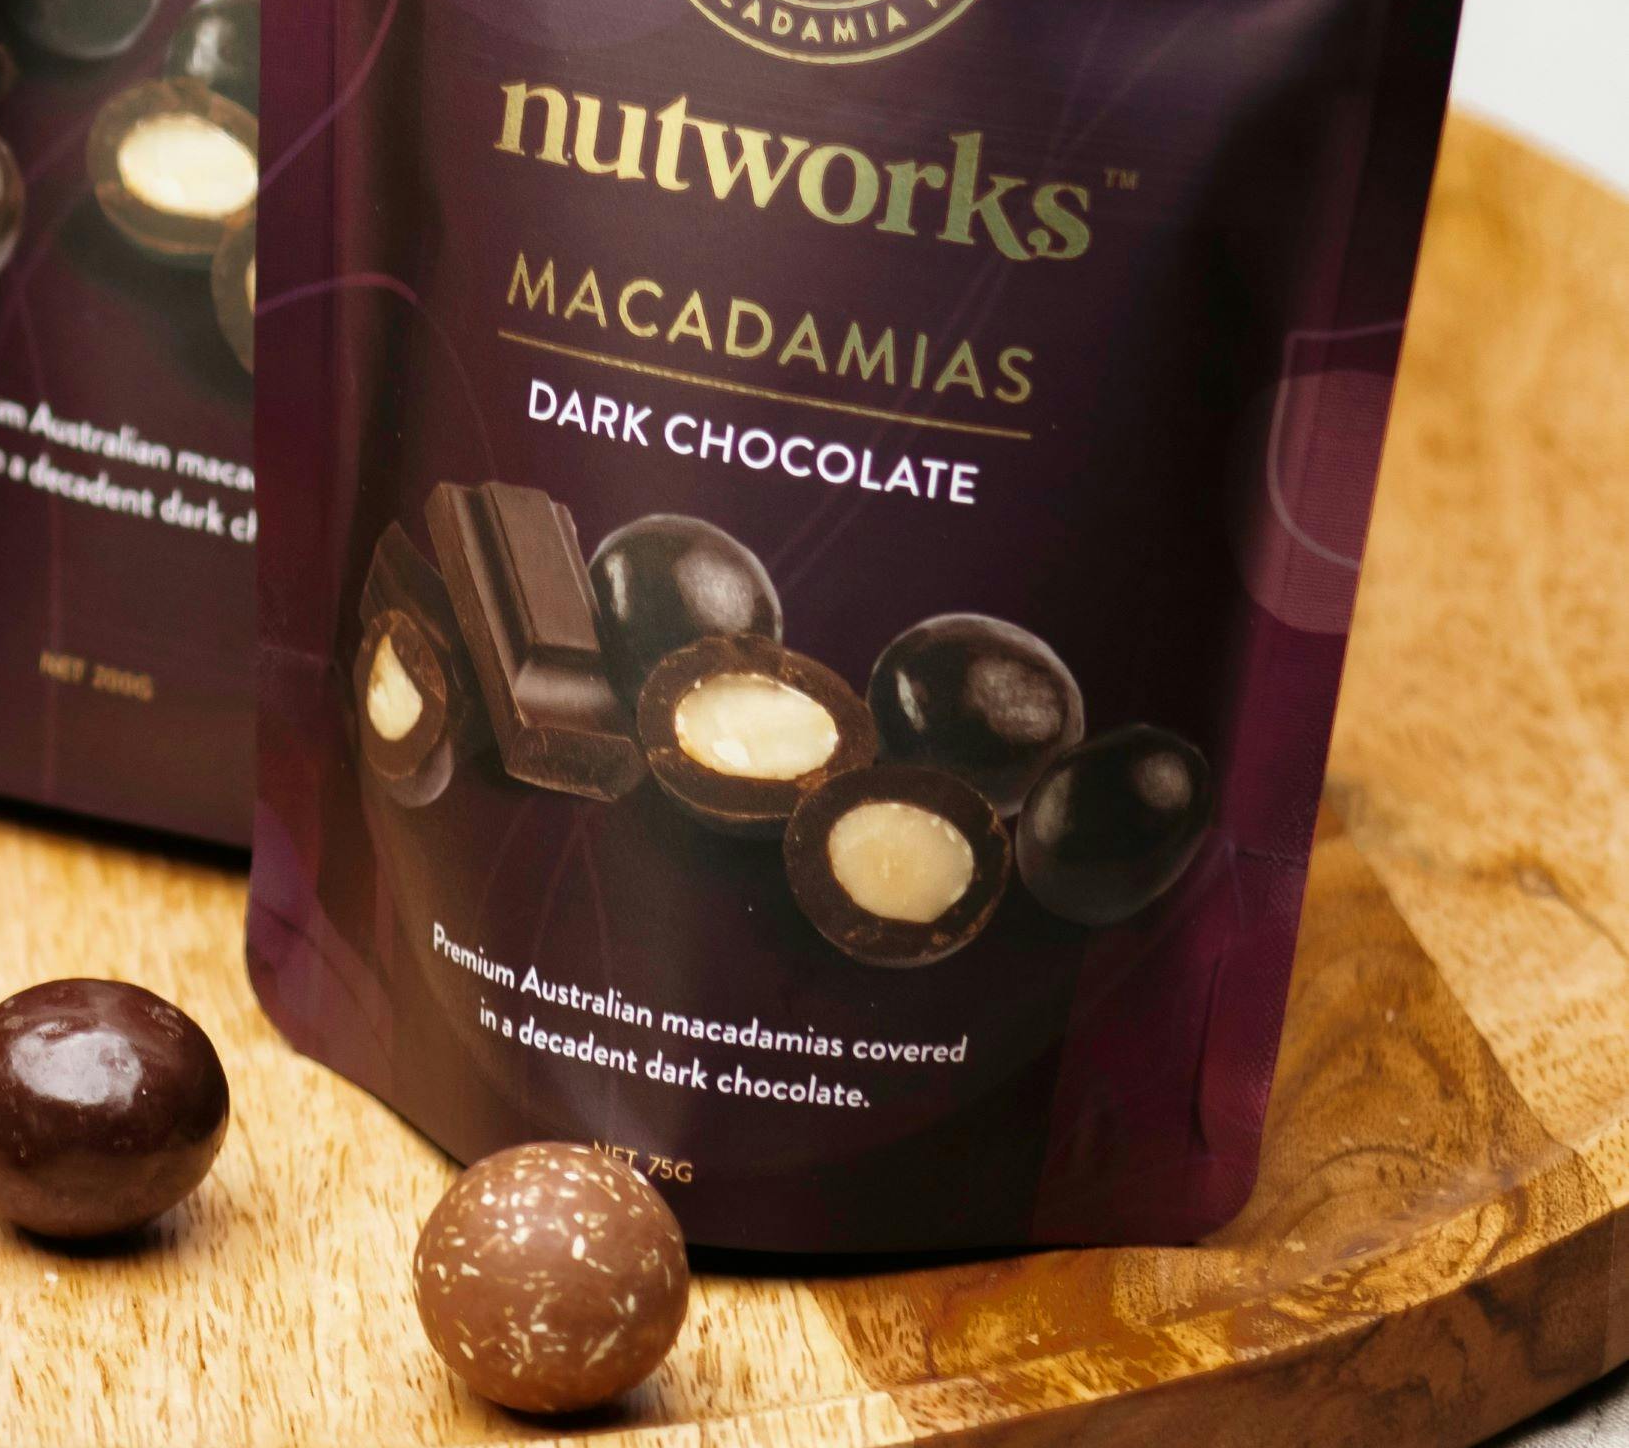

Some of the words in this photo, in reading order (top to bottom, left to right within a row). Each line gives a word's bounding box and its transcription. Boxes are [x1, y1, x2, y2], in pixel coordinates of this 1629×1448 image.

[492, 77, 1093, 264] nutworks
[507, 249, 1035, 406] MACADAMIAS
[28, 453, 155, 520] decadent
[159, 489, 226, 536] dark
[29, 402, 171, 470] Australian
[175, 450, 255, 493] maca
[527, 378, 651, 449] DARK
[664, 413, 980, 506] CHOCOLATE
[431, 922, 516, 990] Premium
[520, 965, 653, 1030] Australian
[661, 1009, 845, 1060] macadamias
[851, 1034, 969, 1065] covered
[478, 995, 498, 1033] in
[500, 1017, 515, 1039] a
[517, 1014, 638, 1075] decadent
[644, 1051, 709, 1091] dark
[715, 1066, 872, 1110] chocolate.
[648, 1154, 693, 1183] 75G
